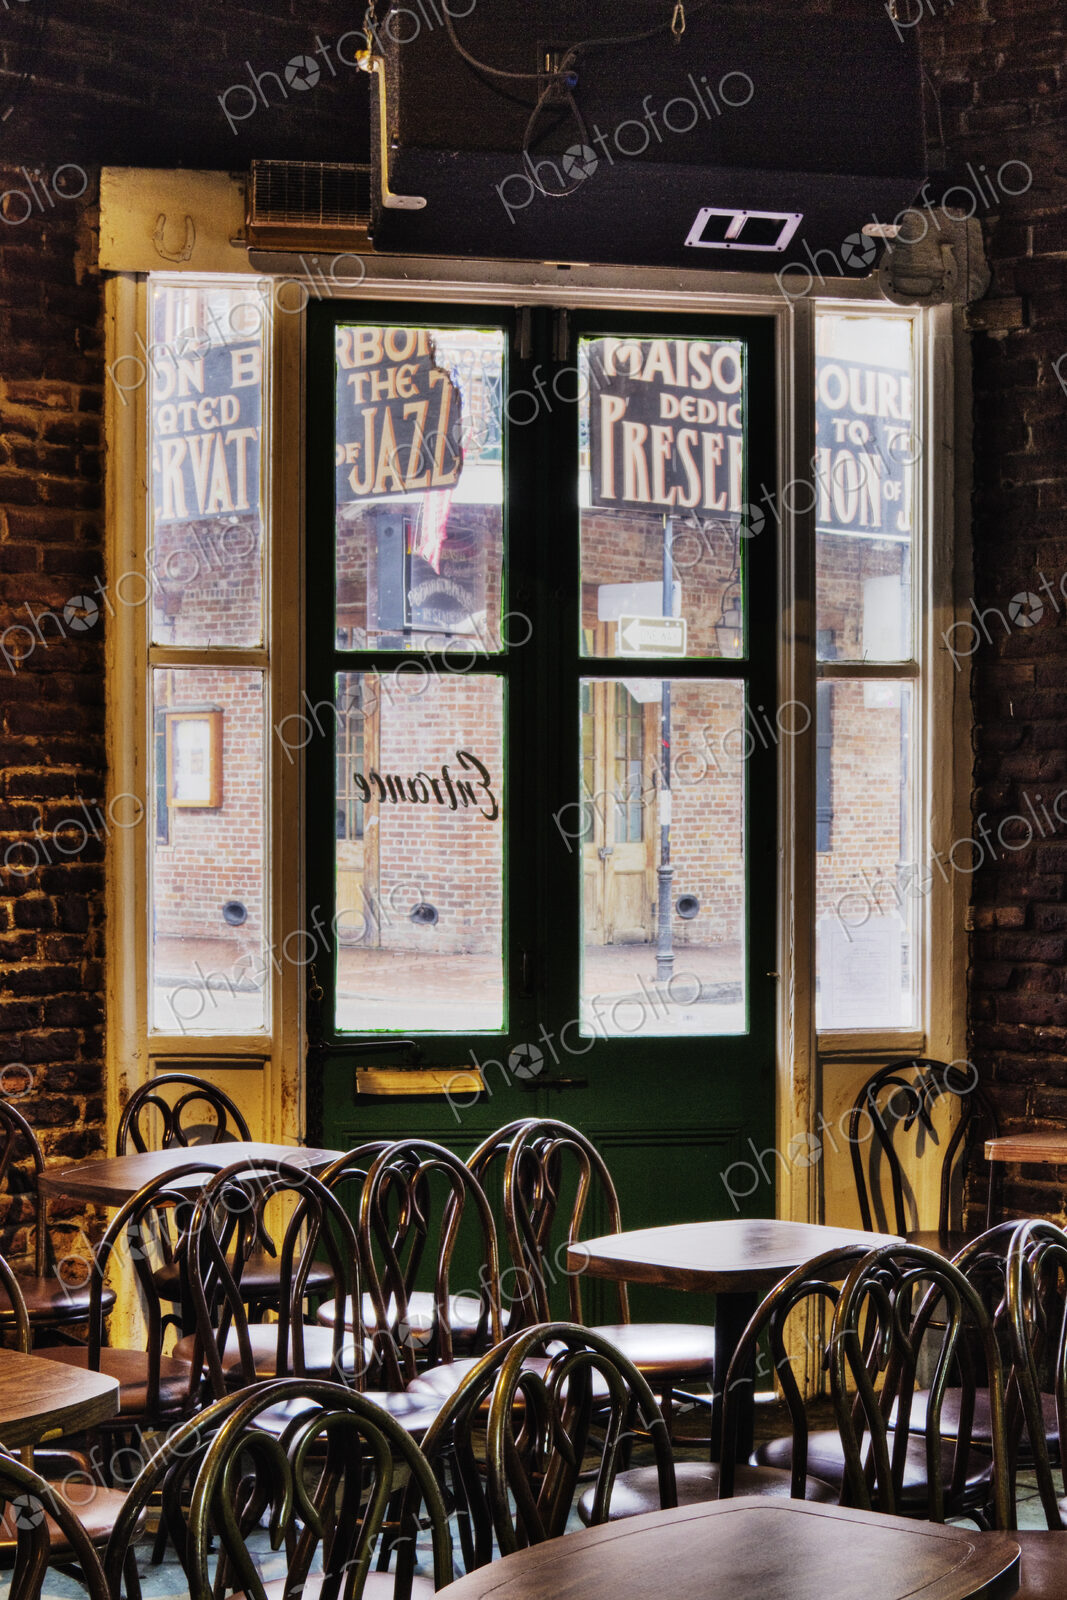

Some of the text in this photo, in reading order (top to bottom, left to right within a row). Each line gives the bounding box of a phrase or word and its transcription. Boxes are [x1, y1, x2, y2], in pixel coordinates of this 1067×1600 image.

[153, 363, 421, 435] ATED THE
[815, 363, 911, 422] OUR
[153, 426, 262, 520] RVAT
[348, 369, 460, 495] JAZZ
[832, 417, 869, 445] TO
[815, 445, 882, 528] ION
[883, 479, 902, 502] OF
